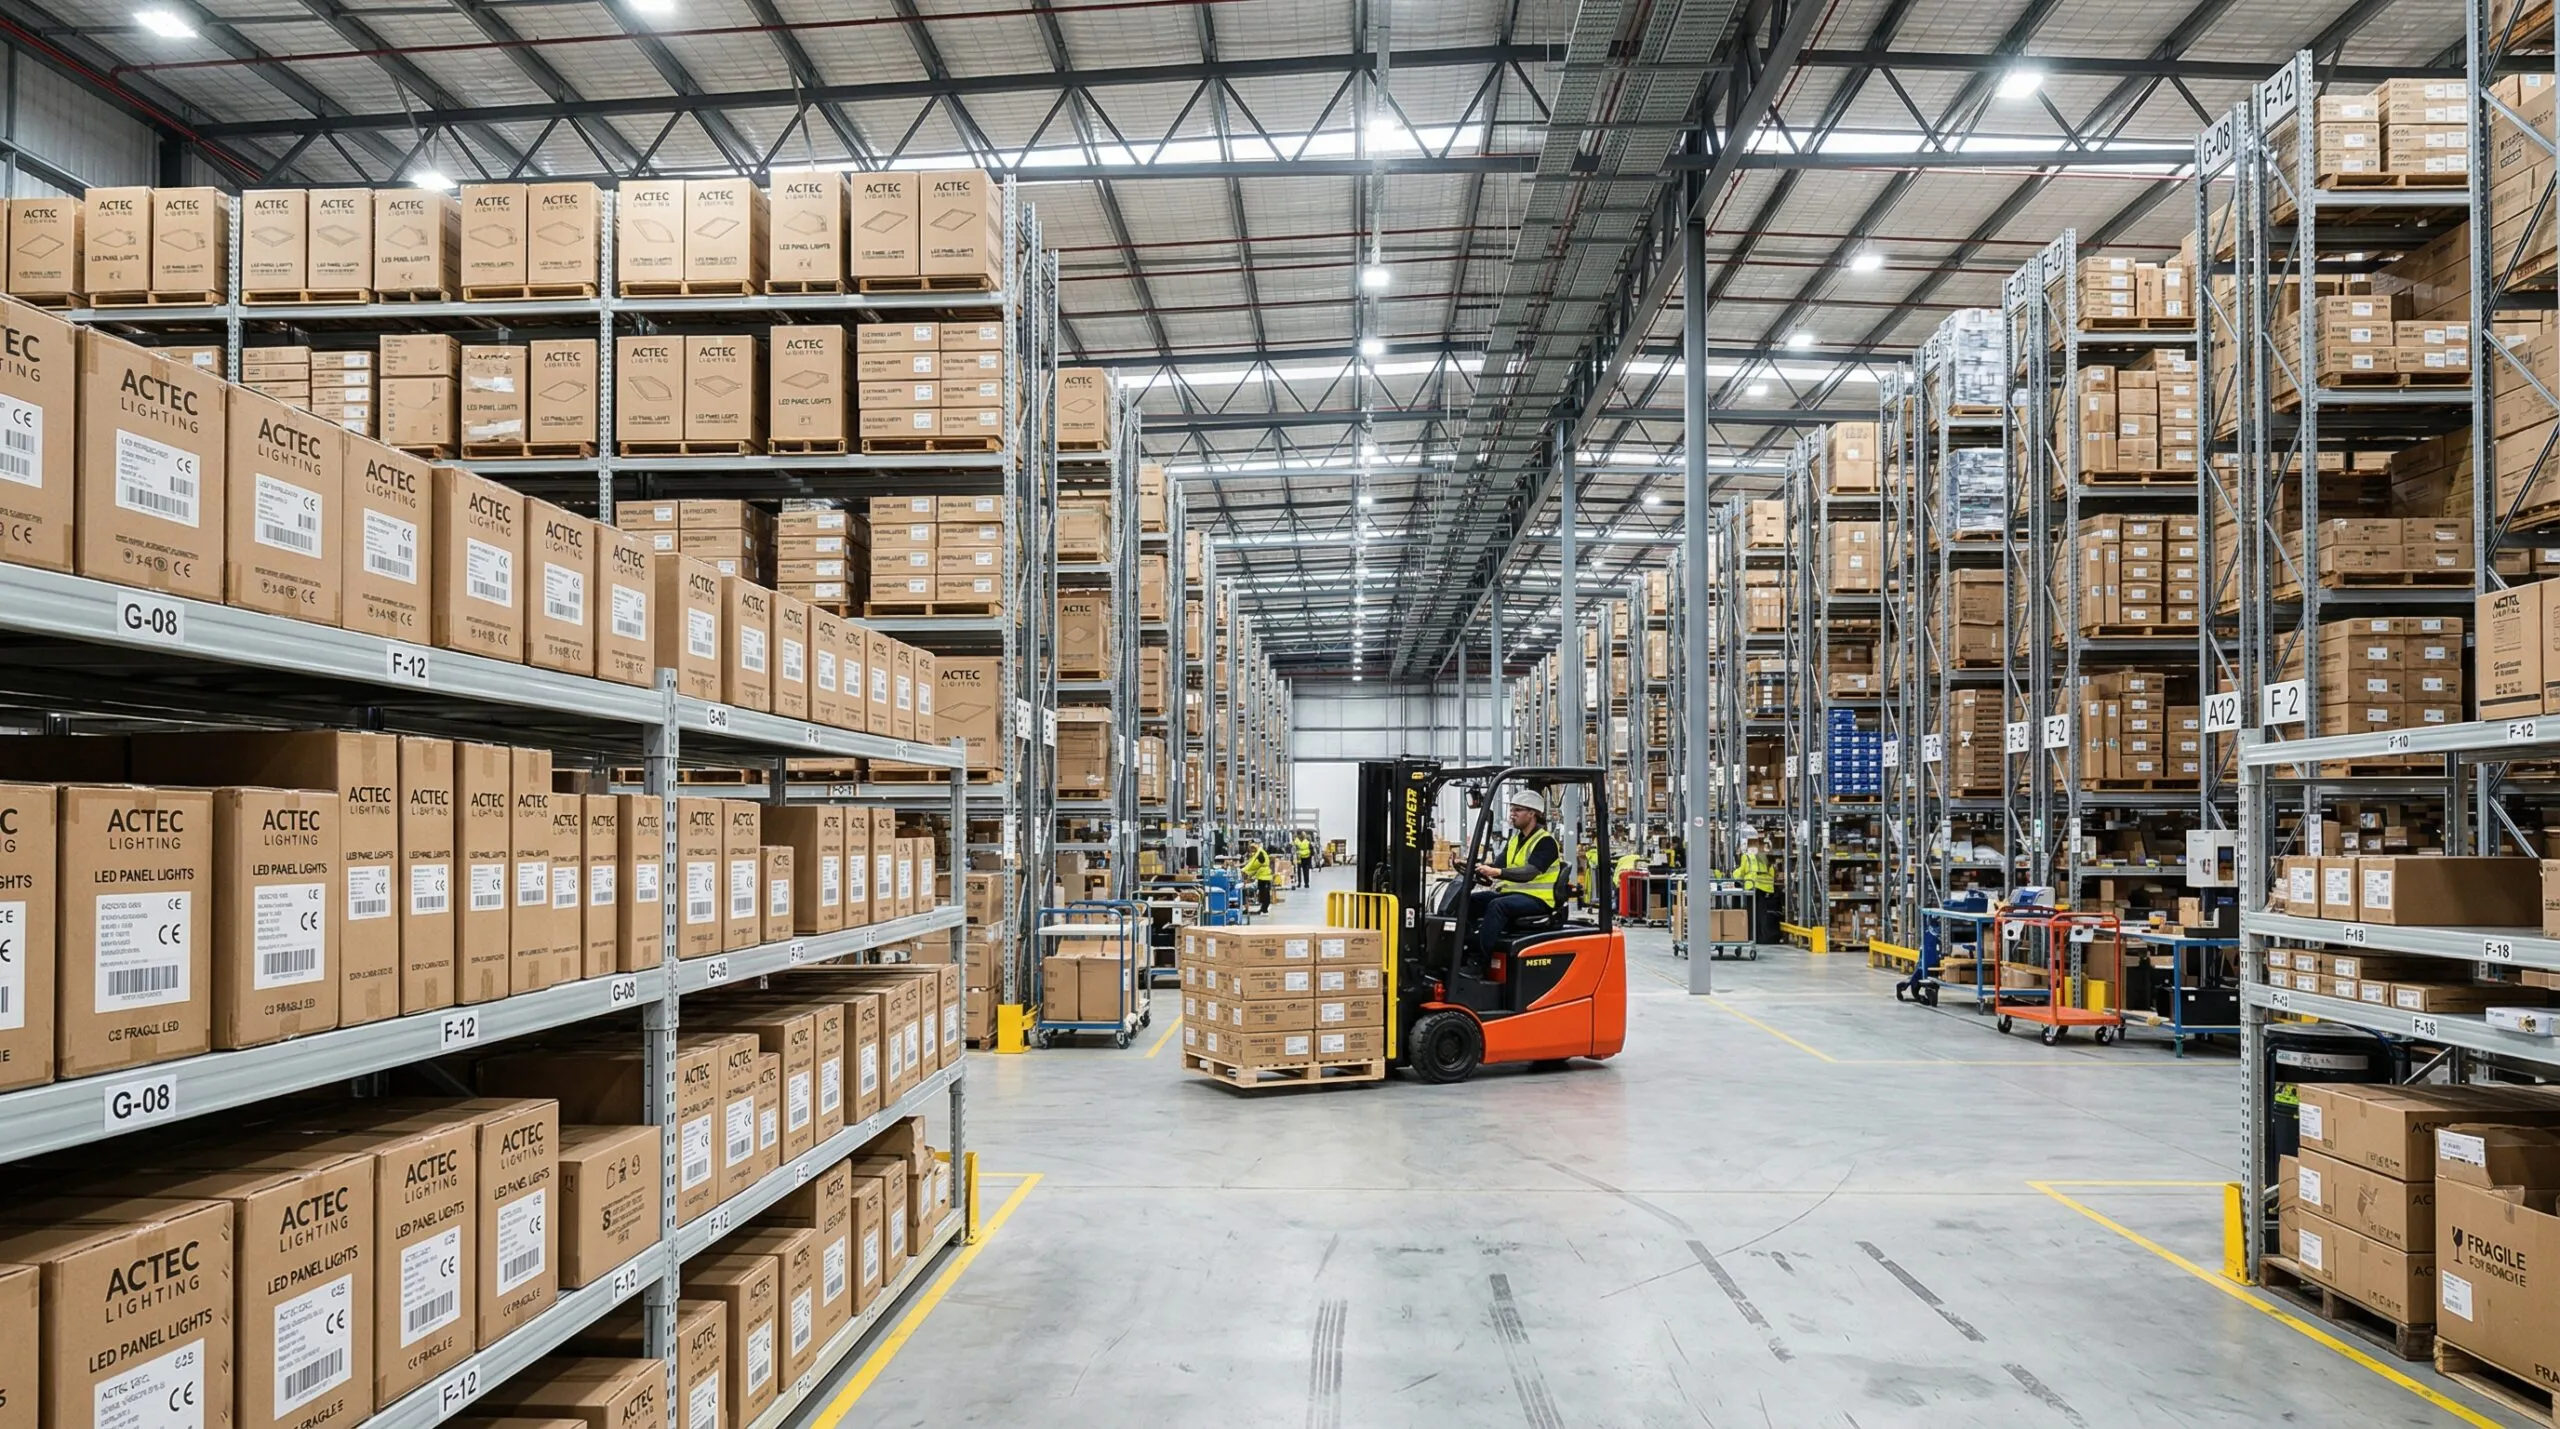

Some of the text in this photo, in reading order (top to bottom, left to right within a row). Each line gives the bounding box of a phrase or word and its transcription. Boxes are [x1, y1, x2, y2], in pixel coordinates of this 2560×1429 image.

[2265, 70, 2293, 117] F-12
[2204, 121, 2230, 164] G-08
[634, 192, 669, 201] ACTEC
[699, 190, 733, 200] ACTEC
[786, 183, 822, 193] ACTEC
[865, 183, 901, 193] ACTEC
[934, 181, 970, 192] ACTEC
[166, 200, 199, 210] ACTEC
[255, 200, 288, 209] ACTEC
[320, 199, 354, 209] ACTEC
[389, 201, 423, 210] ACTEC
[475, 196, 510, 206] ACTEC
[542, 194, 577, 205] ACTEC
[0, 325, 41, 362] EC
[632, 348, 668, 358] ACTEC
[699, 347, 736, 357] ACTEC
[786, 339, 824, 350] ACTEC
[545, 352, 581, 362] ACTEC
[121, 368, 198, 415] ACTEC
[121, 397, 199, 434] LIGHTING
[258, 418, 321, 460] ACTEC
[177, 457, 192, 474] CE
[258, 444, 321, 476] LIGHTING
[366, 459, 416, 494] ACTEC
[469, 493, 511, 523] ACTEC
[546, 520, 582, 548] ACTEC
[613, 544, 645, 569] ACTEC
[174, 561, 191, 578] CE
[689, 573, 715, 595] ACTEC
[742, 591, 765, 613] ACTEC
[124, 603, 178, 635] G-08
[393, 653, 426, 679] F-12
[941, 670, 981, 680] ACTEC
[2208, 698, 2235, 727] A12
[2272, 687, 2298, 717] F 2
[2049, 718, 2065, 743] F-2
[2510, 723, 2534, 739] F-12
[349, 787, 392, 803] ACTEC
[411, 789, 449, 806] ACTEC
[471, 793, 504, 809] ACTEC
[518, 794, 548, 809] ACTEC
[107, 809, 184, 833] ACTEC
[262, 810, 320, 831] ACTEC
[690, 811, 715, 826] ACTEC
[109, 837, 181, 850] LIGHTING
[264, 834, 318, 846] LIGHTING
[95, 867, 195, 883] LED PANEL LIGHTS
[253, 864, 269, 876] LED
[168, 898, 182, 910] CE
[300, 911, 318, 931] CE
[158, 923, 181, 945] CE
[2485, 943, 2510, 958] F-18
[444, 1018, 475, 1042] F-12
[728, 1049, 752, 1071] ACTEC
[684, 1063, 710, 1085] ACTEC
[112, 1085, 170, 1119] G-08
[501, 1121, 544, 1155] ACTEC
[405, 1149, 457, 1189] ACTEC
[405, 1174, 457, 1204] LIGHTING
[280, 1187, 348, 1235] ACTEC
[280, 1215, 348, 1253] LIGHTING
[395, 1216, 411, 1240] LED
[412, 1210, 436, 1235] PANEL
[529, 1216, 541, 1234] CE
[2468, 1233, 2526, 1270] FRAGILE
[105, 1241, 200, 1302] ACTEC
[268, 1245, 358, 1296] LED PANEL LIGHTS
[440, 1256, 455, 1277] CE
[614, 1269, 637, 1298] F-12
[106, 1274, 200, 1323] LIGHTING
[326, 1309, 345, 1335] CE
[89, 1308, 213, 1374] LED PANEL LIGHTS
[692, 1322, 717, 1350] ACTEC
[169, 1381, 194, 1412] CE
[443, 1371, 476, 1412] F-12
[623, 1385, 654, 1421] ACTEC
